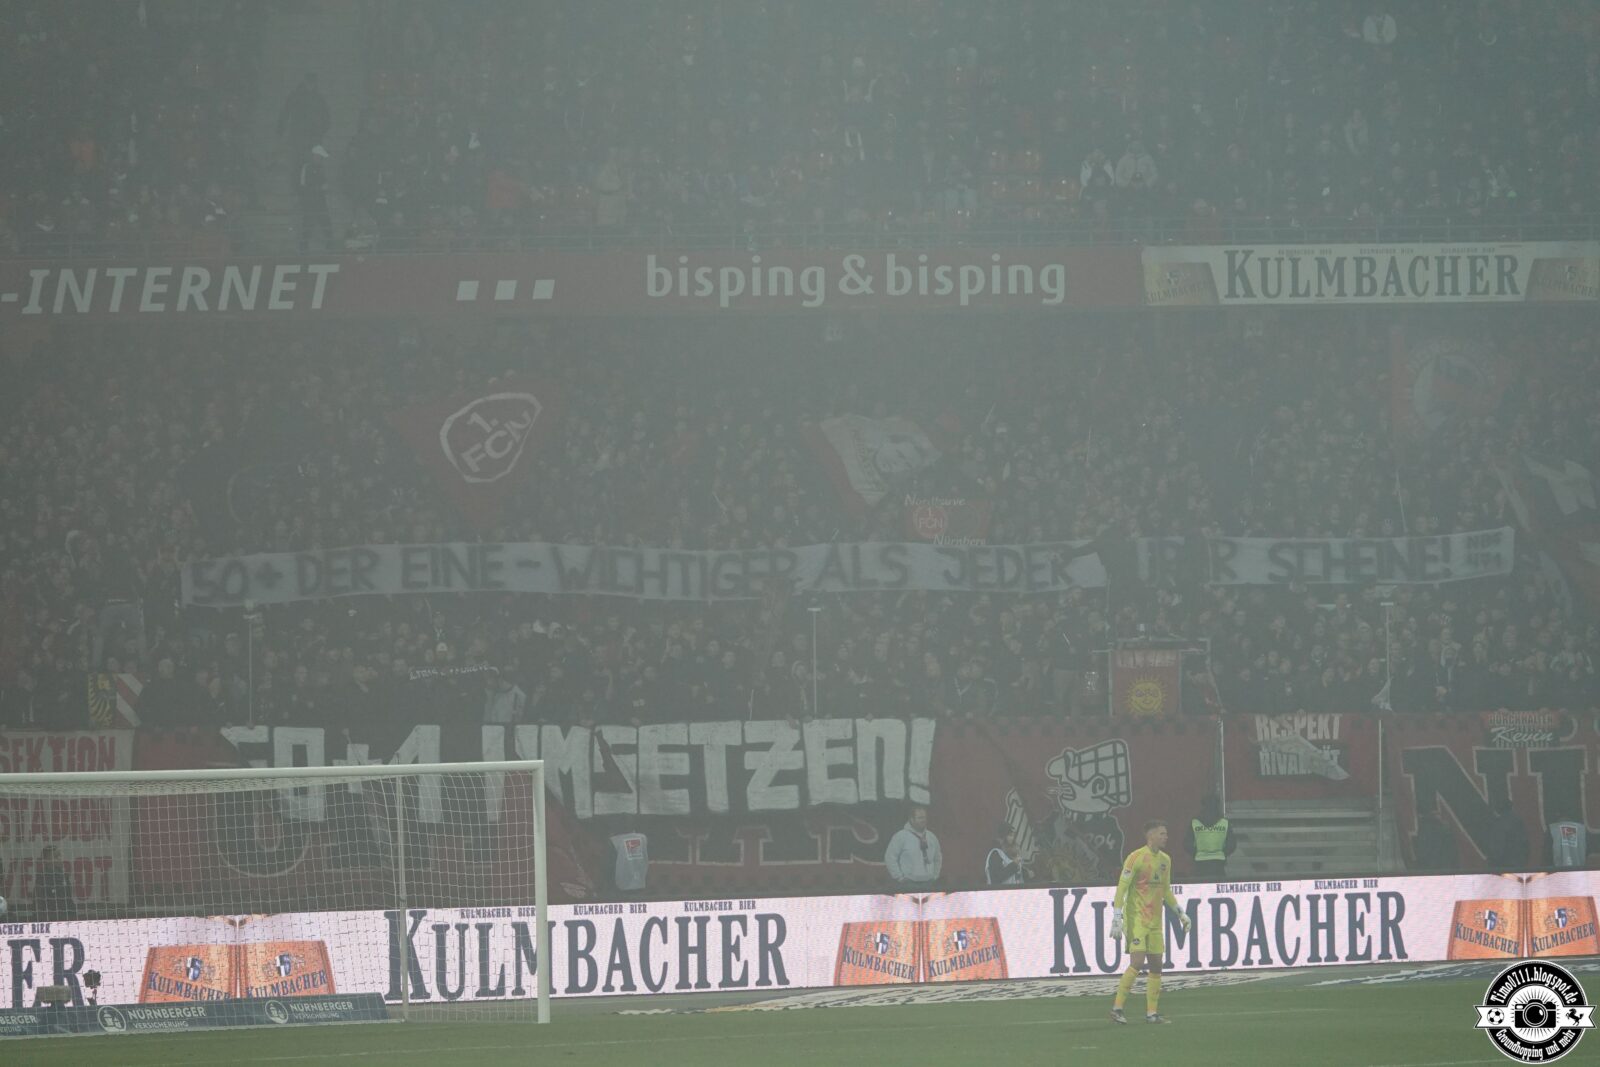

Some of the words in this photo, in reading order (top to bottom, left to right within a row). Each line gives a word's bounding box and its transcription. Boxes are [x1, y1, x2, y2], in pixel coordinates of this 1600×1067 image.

[646, 254, 826, 308] bisping
[838, 253, 876, 297] &
[885, 252, 1067, 306] bisping
[1223, 249, 1521, 299] KULMBACHER
[461, 410, 532, 472] FCN
[296, 548, 378, 595] DER
[403, 545, 505, 590] EINE
[551, 544, 798, 598] WICHTIGER
[813, 543, 908, 590] ALS
[933, 545, 1074, 588] JEDER
[1267, 534, 1453, 584] SCHEINE!
[1255, 713, 1344, 741] RESPEKT
[1490, 726, 1554, 744] Kevin
[0, 855, 113, 900] VEOT
[1216, 883, 1261, 894] KULMBACHER
[1265, 883, 1283, 893] BIER
[1314, 880, 1360, 890] KULMBACHER
[1363, 879, 1379, 889] BIER
[460, 907, 512, 919] KULMBACHER
[573, 903, 623, 916] KULMBACHER
[629, 903, 648, 914] BIER
[684, 901, 733, 913] KULMBACHER
[739, 901, 757, 911] BIER
[32, 923, 51, 934] BIER
[1049, 889, 1408, 973] KUMBACHER
[1454, 922, 1521, 957] KULMBACHER
[1531, 922, 1597, 955] KULMBACHER
[384, 909, 790, 1000] KULMBACHER
[842, 946, 917, 982] KULMBACHER
[927, 945, 1001, 977] KULMBACHER
[149, 971, 232, 1001] KULMBACHER
[127, 1006, 207, 1021] NÜRNBERGER
[289, 1001, 354, 1012] NÜRNBERGER
[132, 1020, 189, 1030] VERSICHERUNG
